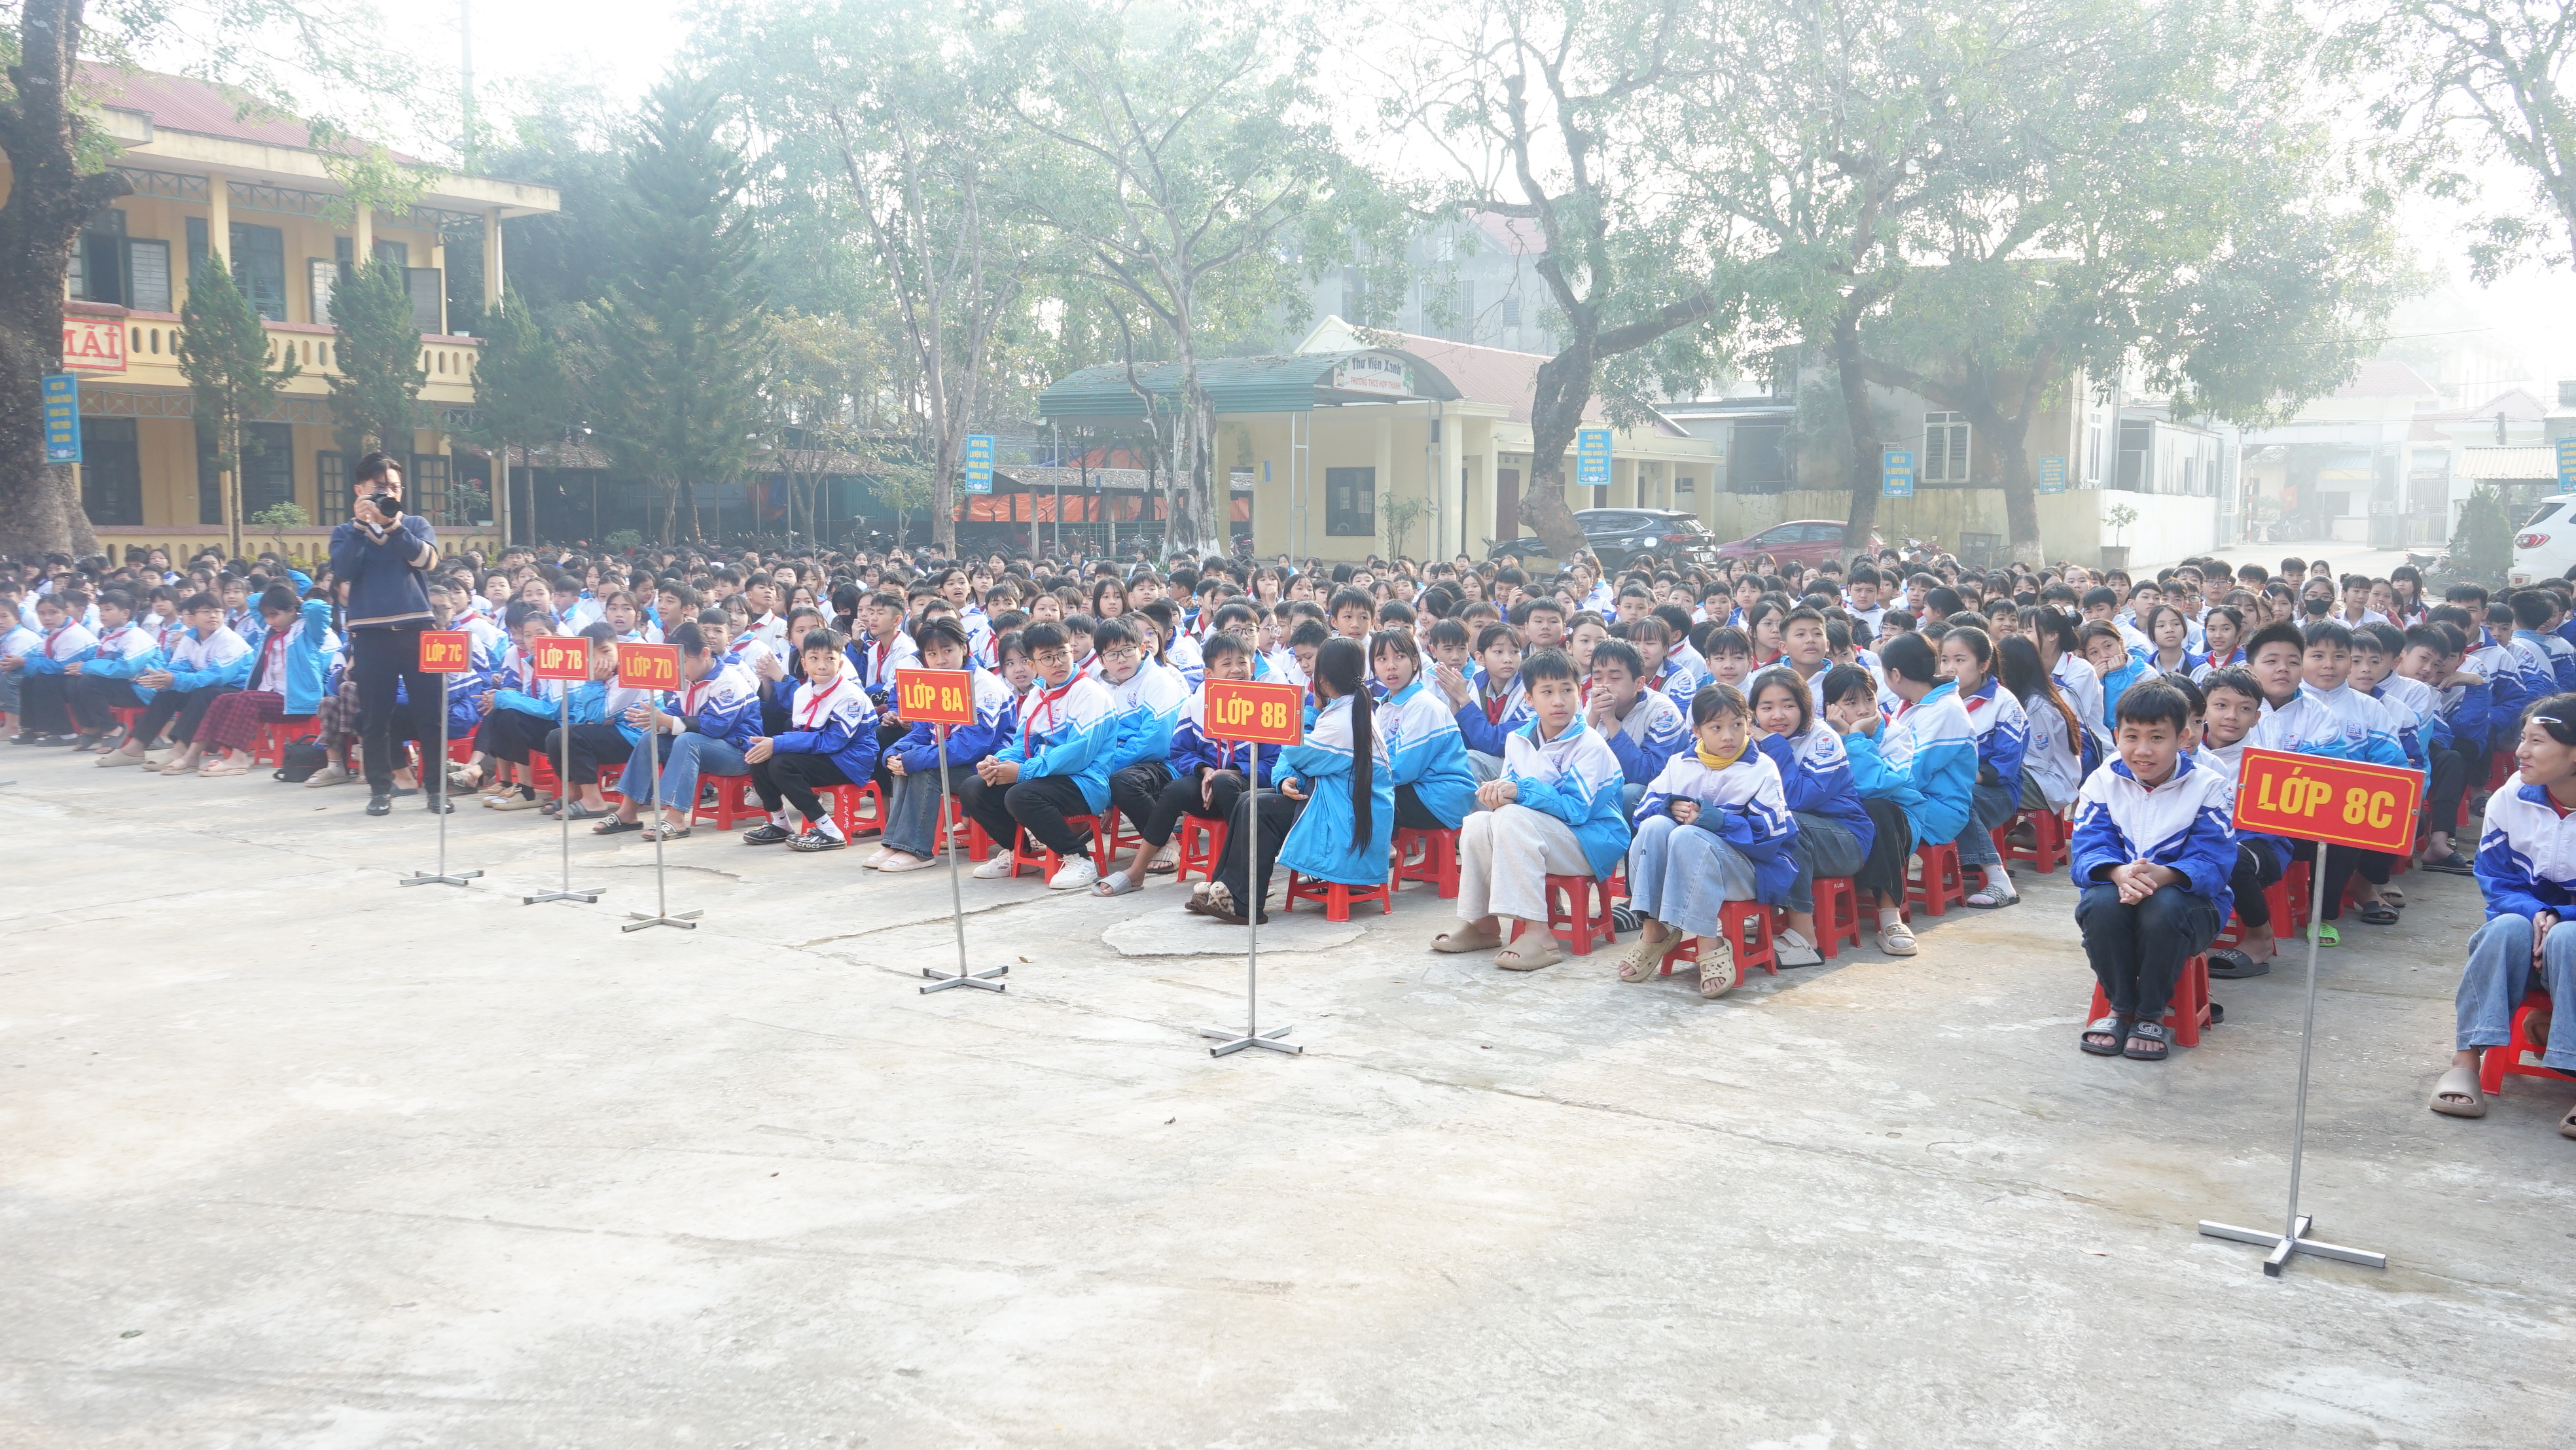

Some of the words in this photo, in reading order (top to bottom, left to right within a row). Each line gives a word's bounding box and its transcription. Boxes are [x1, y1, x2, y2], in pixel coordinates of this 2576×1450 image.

[1352, 357, 1366, 370] Thư
[1368, 357, 1382, 372] Viện
[1384, 359, 1401, 376] Xanh
[425, 638, 446, 662] LỚP
[448, 644, 463, 662] 7C
[540, 643, 564, 669] LỚP
[565, 649, 582, 669] 7B
[626, 651, 651, 677] LỚP
[654, 658, 673, 679] 7D
[904, 678, 936, 709] LỚP
[941, 687, 964, 712] 8A
[1216, 691, 1254, 726] LỚP
[1261, 701, 1287, 728] 8B
[2257, 766, 2333, 817] LỚP
[2342, 787, 2395, 829] 8C
